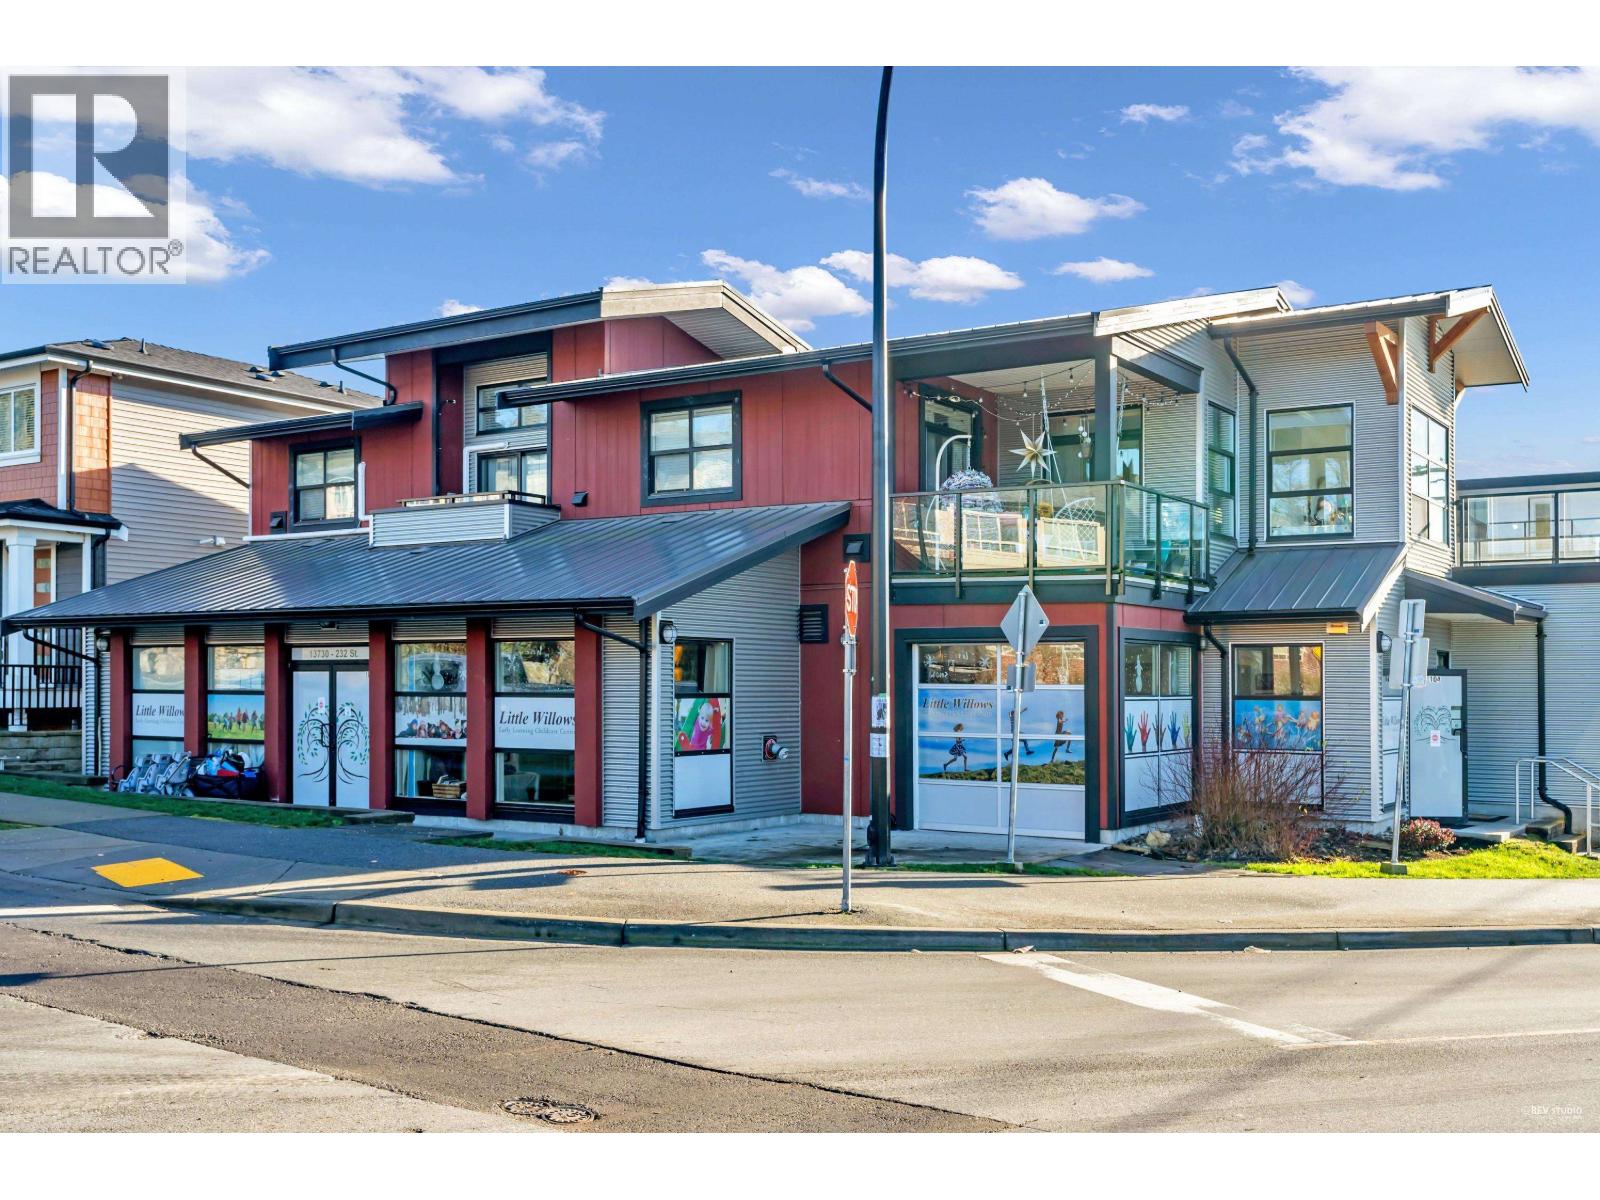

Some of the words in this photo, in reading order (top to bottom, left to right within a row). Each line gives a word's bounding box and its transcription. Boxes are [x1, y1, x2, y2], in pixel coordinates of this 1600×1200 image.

[309, 649, 330, 658] 13730
[335, 649, 348, 658] 232
[923, 698, 949, 709] Little
[953, 698, 993, 709] Willows
[135, 704, 157, 717] Little
[499, 711, 529, 725] Little
